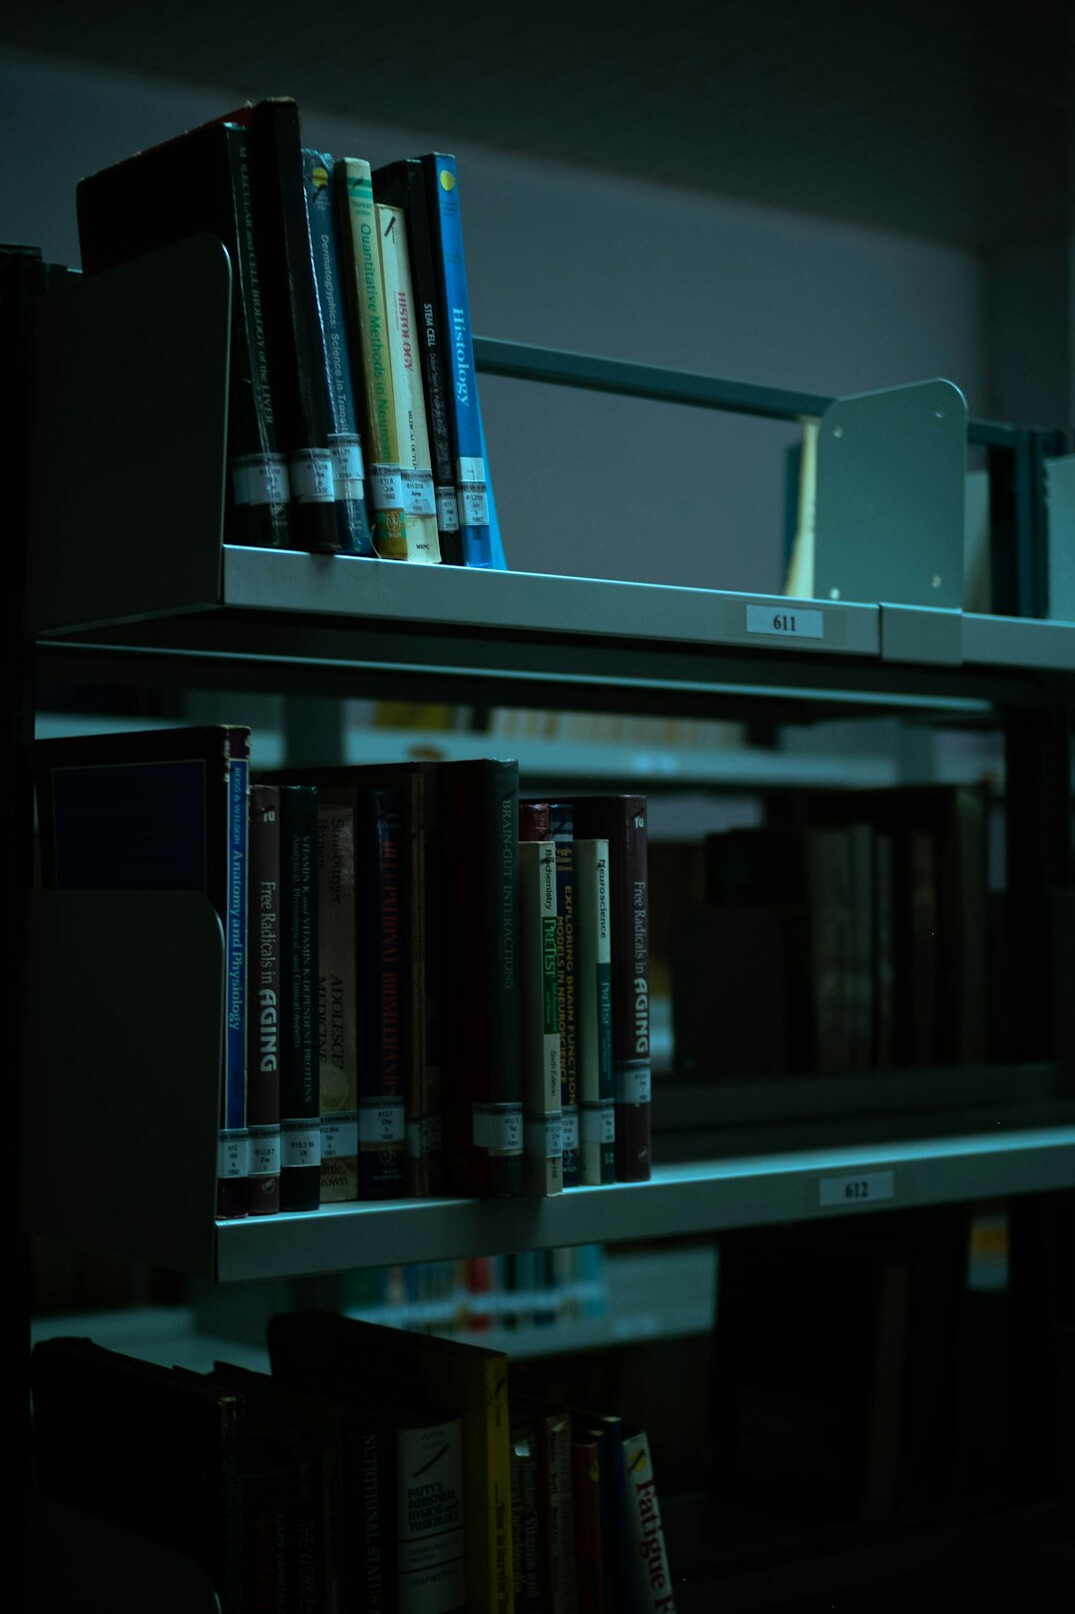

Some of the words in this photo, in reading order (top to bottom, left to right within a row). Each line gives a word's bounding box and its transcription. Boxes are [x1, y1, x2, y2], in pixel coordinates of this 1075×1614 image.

[361, 222, 379, 312] Quantitative
[321, 234, 338, 329] Dermatoglyphics:
[331, 333, 343, 375] Science
[338, 394, 348, 433] Transit
[370, 315, 387, 375] Methods
[398, 292, 413, 372] HISTOLOGY
[423, 303, 434, 326] STEM
[426, 327, 436, 347] CELL
[253, 290, 265, 347] BIOLOGY
[264, 384, 273, 424] LIVER
[375, 378, 387, 394] in
[452, 307, 470, 407] Histology
[773, 615, 796, 631] 611
[302, 836, 310, 882] VITAMIN
[331, 818, 344, 904] Strasburger
[502, 799, 513, 881] BRAIN-GUT
[230, 850, 244, 917] Anatomy
[261, 881, 276, 911] Free
[380, 839, 399, 963] OCCUPATIONAL
[598, 859, 607, 939] Neuroscience
[634, 881, 646, 911] Free
[231, 918, 244, 949] and
[261, 913, 277, 967] Radicals
[302, 917, 311, 965] VITAMIN
[503, 885, 514, 990] INTERACTIONS
[557, 916, 566, 968] MODELS
[564, 885, 575, 971] EXPLORING
[634, 913, 648, 960] Radicals
[230, 951, 244, 1031] Physiology
[262, 970, 277, 984] in
[566, 975, 576, 1021] BRAIN
[635, 961, 646, 974] in
[259, 989, 277, 1072] AGING
[302, 968, 312, 1045] K-DEPENDENT
[318, 976, 327, 1063] MEDICINE
[558, 987, 568, 1084] NEUROSCIENCE
[634, 978, 649, 1054] AGING
[303, 1048, 313, 1103] PROTEINS
[567, 1025, 578, 1105] FUNCTION
[845, 1182, 868, 1198] 612
[362, 1433, 380, 1544] NUTRITIONAL
[511, 1504, 526, 1594] Encyclopedia
[525, 1517, 540, 1568] Vitamin
[635, 1479, 666, 1591] Fatigue
[367, 1546, 382, 1605] STATUS
[526, 1571, 540, 1597] and
